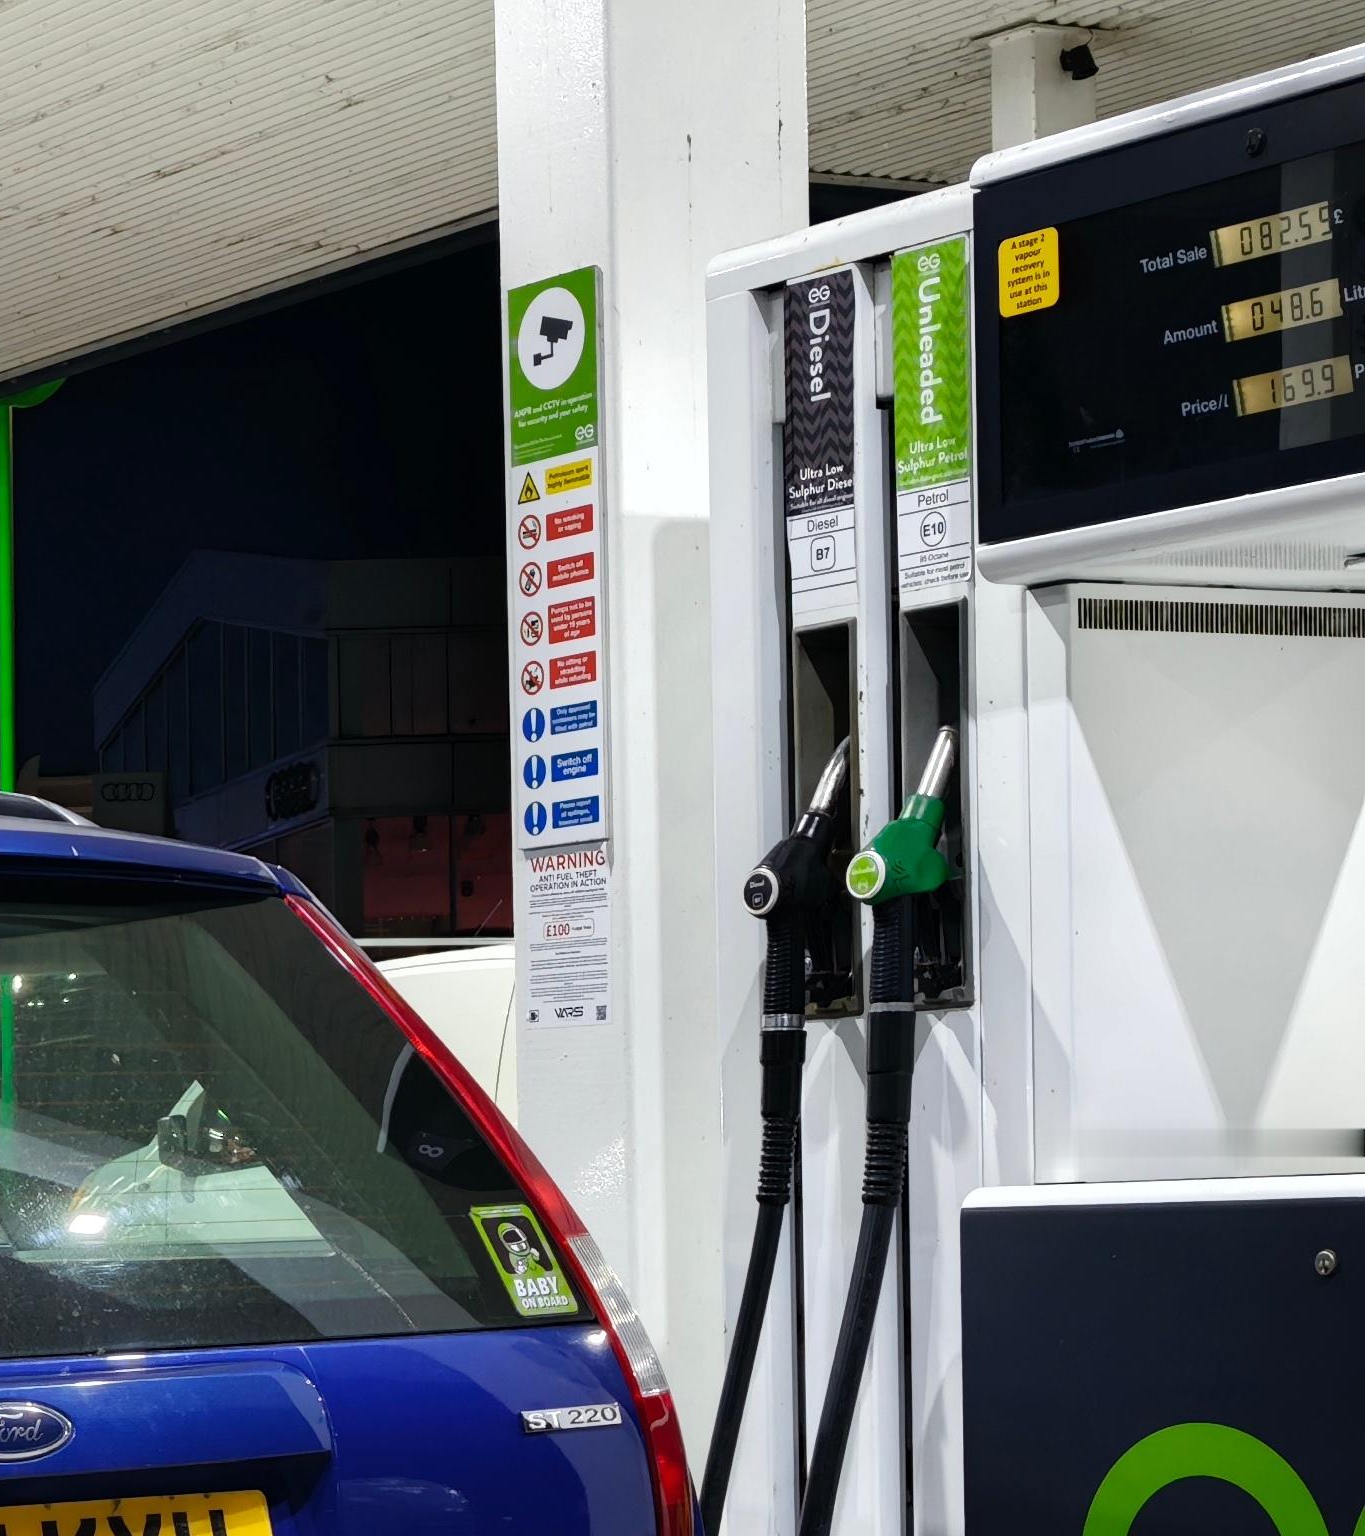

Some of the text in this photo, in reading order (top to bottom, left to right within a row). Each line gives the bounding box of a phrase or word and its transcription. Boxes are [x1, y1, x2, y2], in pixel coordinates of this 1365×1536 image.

[1333, 208, 1344, 224] £
[1011, 234, 1045, 250] A stage 2
[1015, 248, 1041, 261] vapour
[1140, 246, 1207, 273] Total Sale
[1012, 260, 1045, 274] recovery
[1007, 270, 1050, 288] system is in
[1010, 282, 1048, 299] use at this
[1016, 297, 1042, 309] station
[1251, 288, 1323, 331] 048.6
[1163, 320, 1218, 345] Amount
[809, 308, 831, 402] Diesel
[918, 276, 943, 425] Unleaded
[1271, 364, 1335, 404] 169.9
[909, 435, 956, 454] Ultra Low
[898, 446, 967, 475] Sulphur Petrol
[799, 463, 844, 480] Ultra Low
[789, 483, 825, 500] Sulphur
[917, 489, 949, 507] Petrol
[807, 515, 838, 532] Diesel
[923, 521, 944, 537] E10
[816, 547, 830, 560] B7
[557, 753, 593, 768] Switch off
[562, 765, 587, 776] engine
[530, 850, 606, 873] WARNING
[530, 881, 569, 893] OPERATION
[571, 880, 579, 888] IN
[580, 877, 607, 887] ACTION
[538, 869, 597, 884] ANTI FUEL THEFT
[546, 923, 570, 937] £100
[513, 1276, 559, 1297] BABY
[521, 1295, 569, 1310] ON BOARD
[526, 1406, 618, 1430] ST 220
